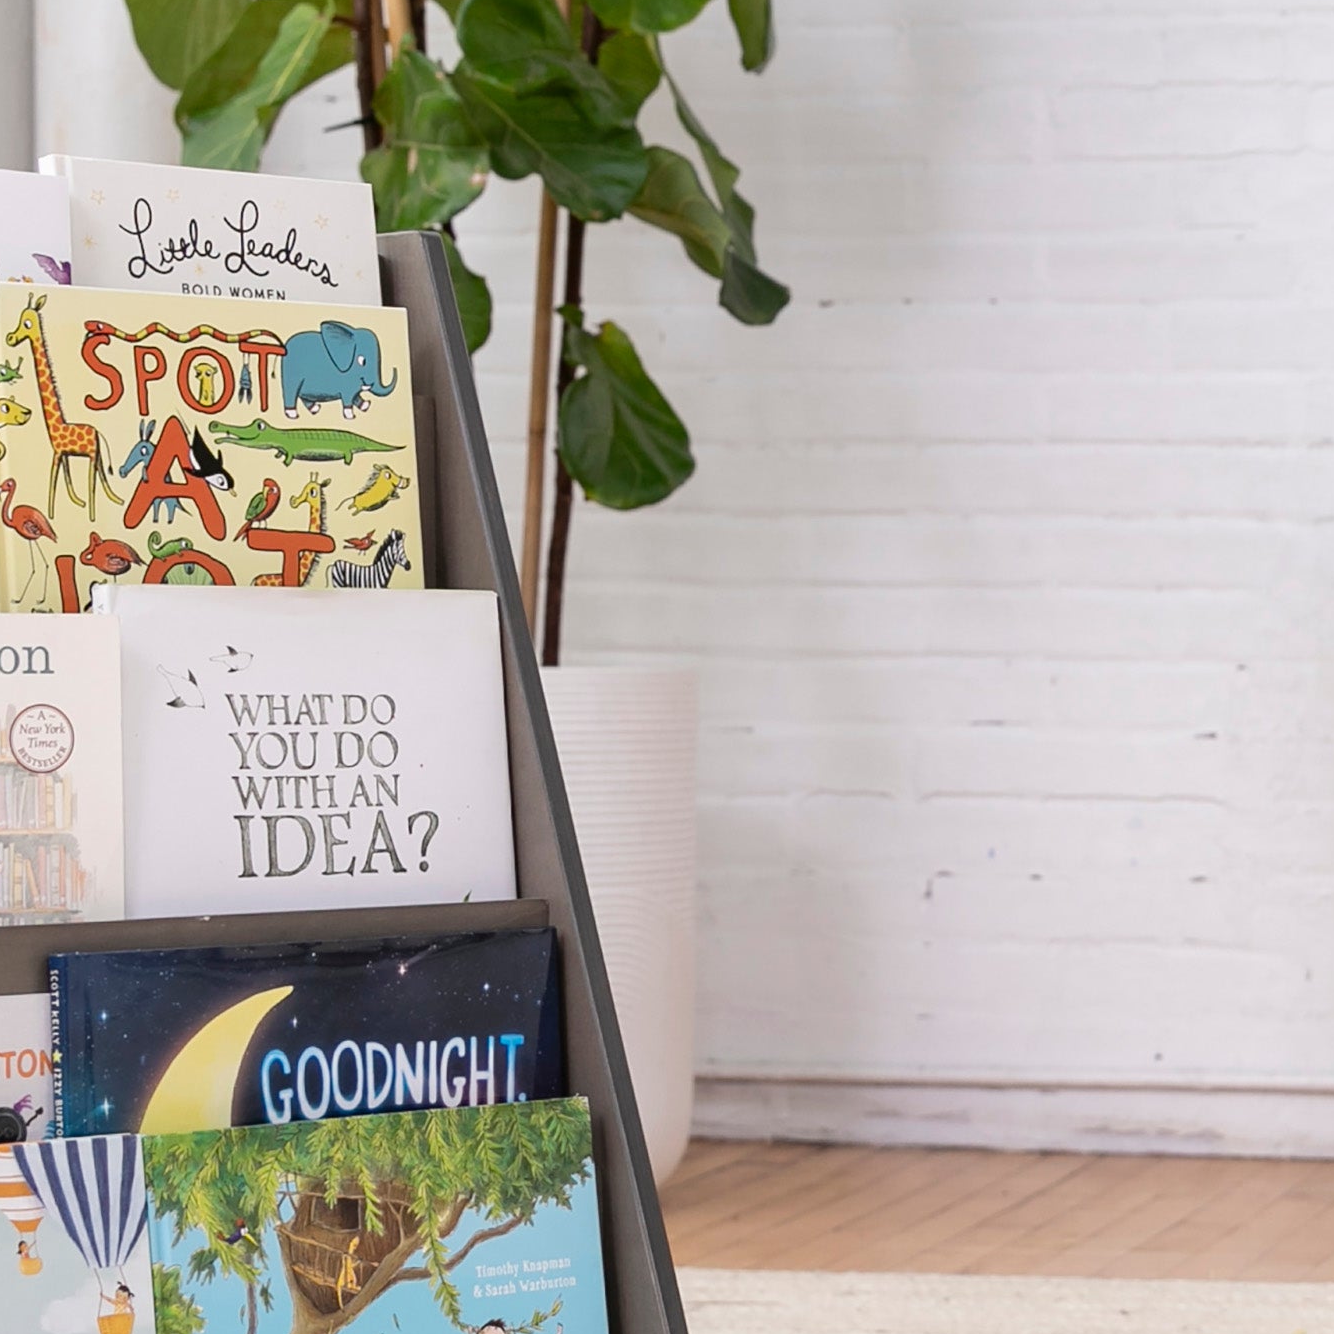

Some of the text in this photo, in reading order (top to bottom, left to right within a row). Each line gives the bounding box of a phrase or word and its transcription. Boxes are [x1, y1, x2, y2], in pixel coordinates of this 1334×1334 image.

[119, 197, 339, 287] Little Leaders
[81, 332, 287, 416] SPOT
[123, 415, 227, 541] A
[37, 710, 46, 720] A
[225, 693, 396, 726] WHAT DO
[19, 722, 65, 734] New York
[27, 737, 58, 748] Times
[18, 746, 67, 767] BESTSELLER
[228, 730, 399, 770] YOU DO
[231, 774, 400, 810] WITH AN
[233, 810, 440, 878] IDEA?
[50, 969, 64, 1139] SCOTT KELLY IZZY BURTO
[475, 1257, 571, 1278] Timothy Knapman
[473, 1276, 576, 1298] & Sarah Warburton
